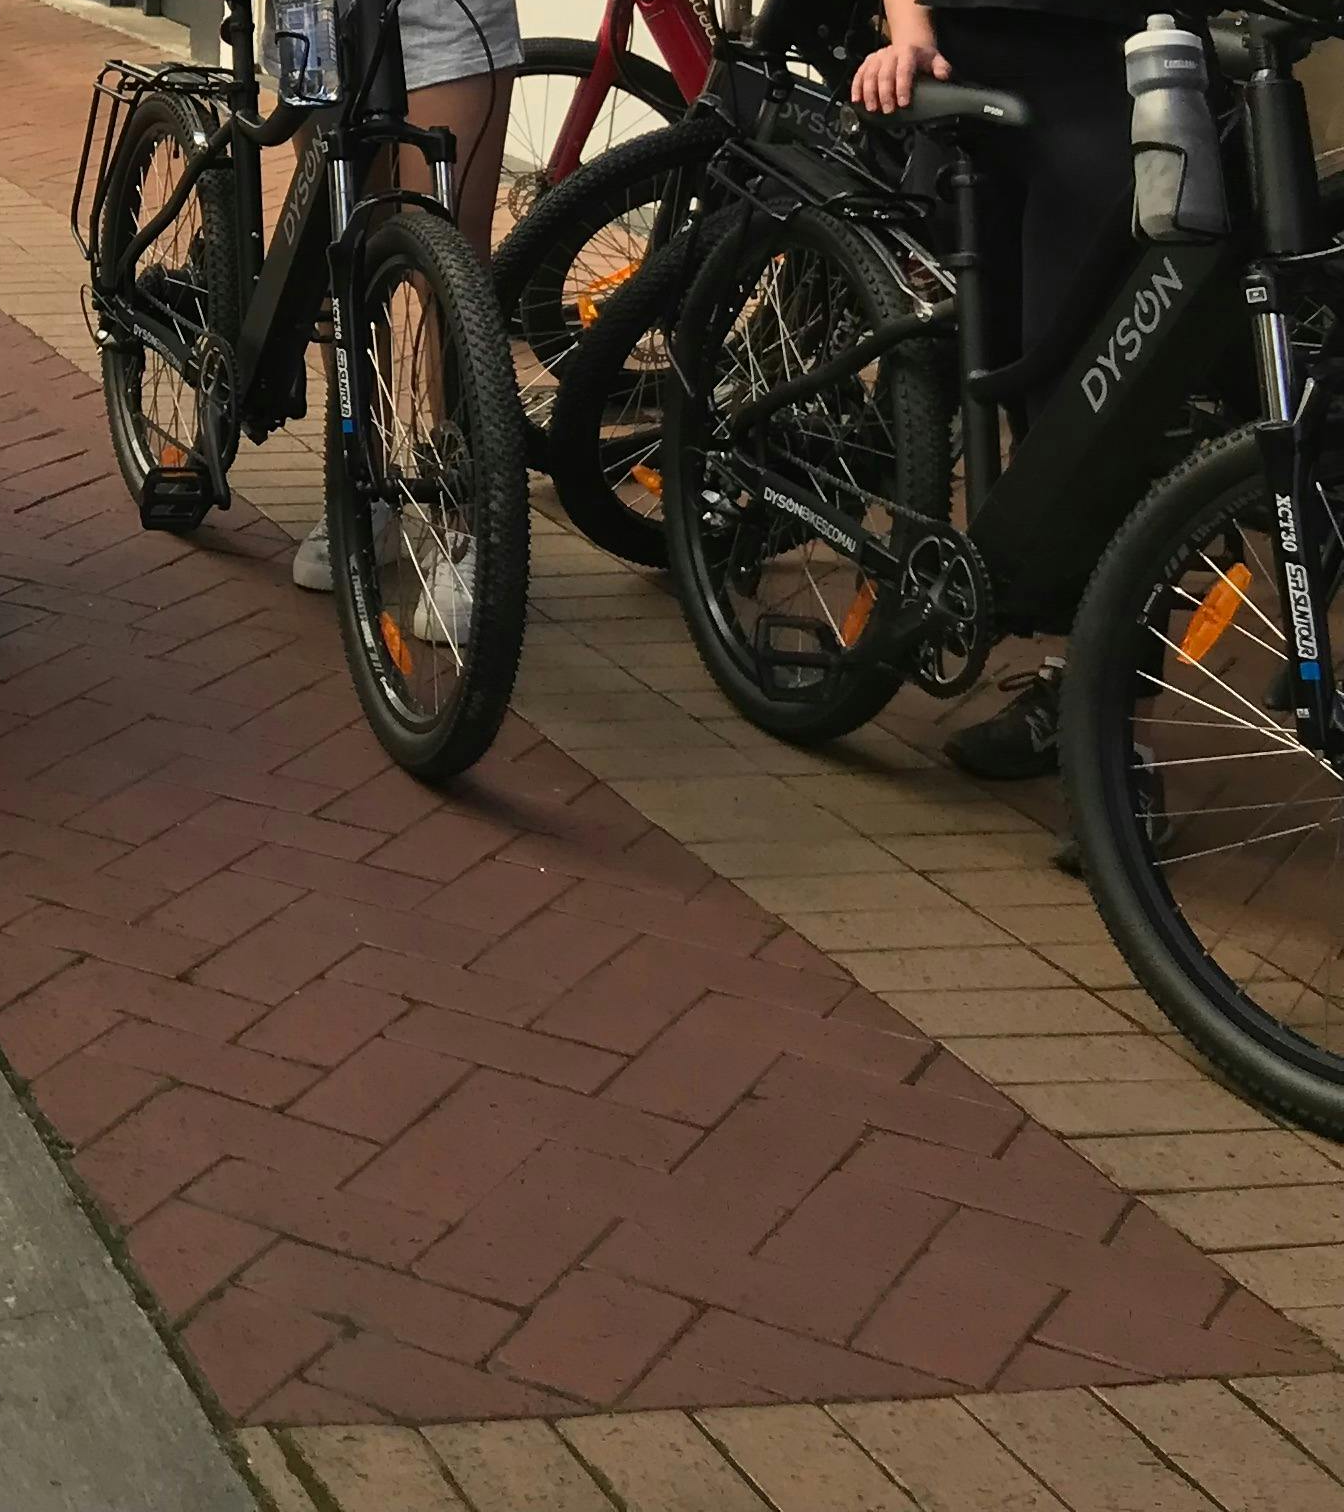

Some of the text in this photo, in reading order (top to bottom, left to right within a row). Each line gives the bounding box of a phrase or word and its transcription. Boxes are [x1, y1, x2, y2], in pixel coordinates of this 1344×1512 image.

[283, 124, 324, 246] DYSON
[1080, 256, 1183, 413] DYSON
[1275, 493, 1299, 553] XCT30
[1288, 591, 1318, 660] SUNTOUR
